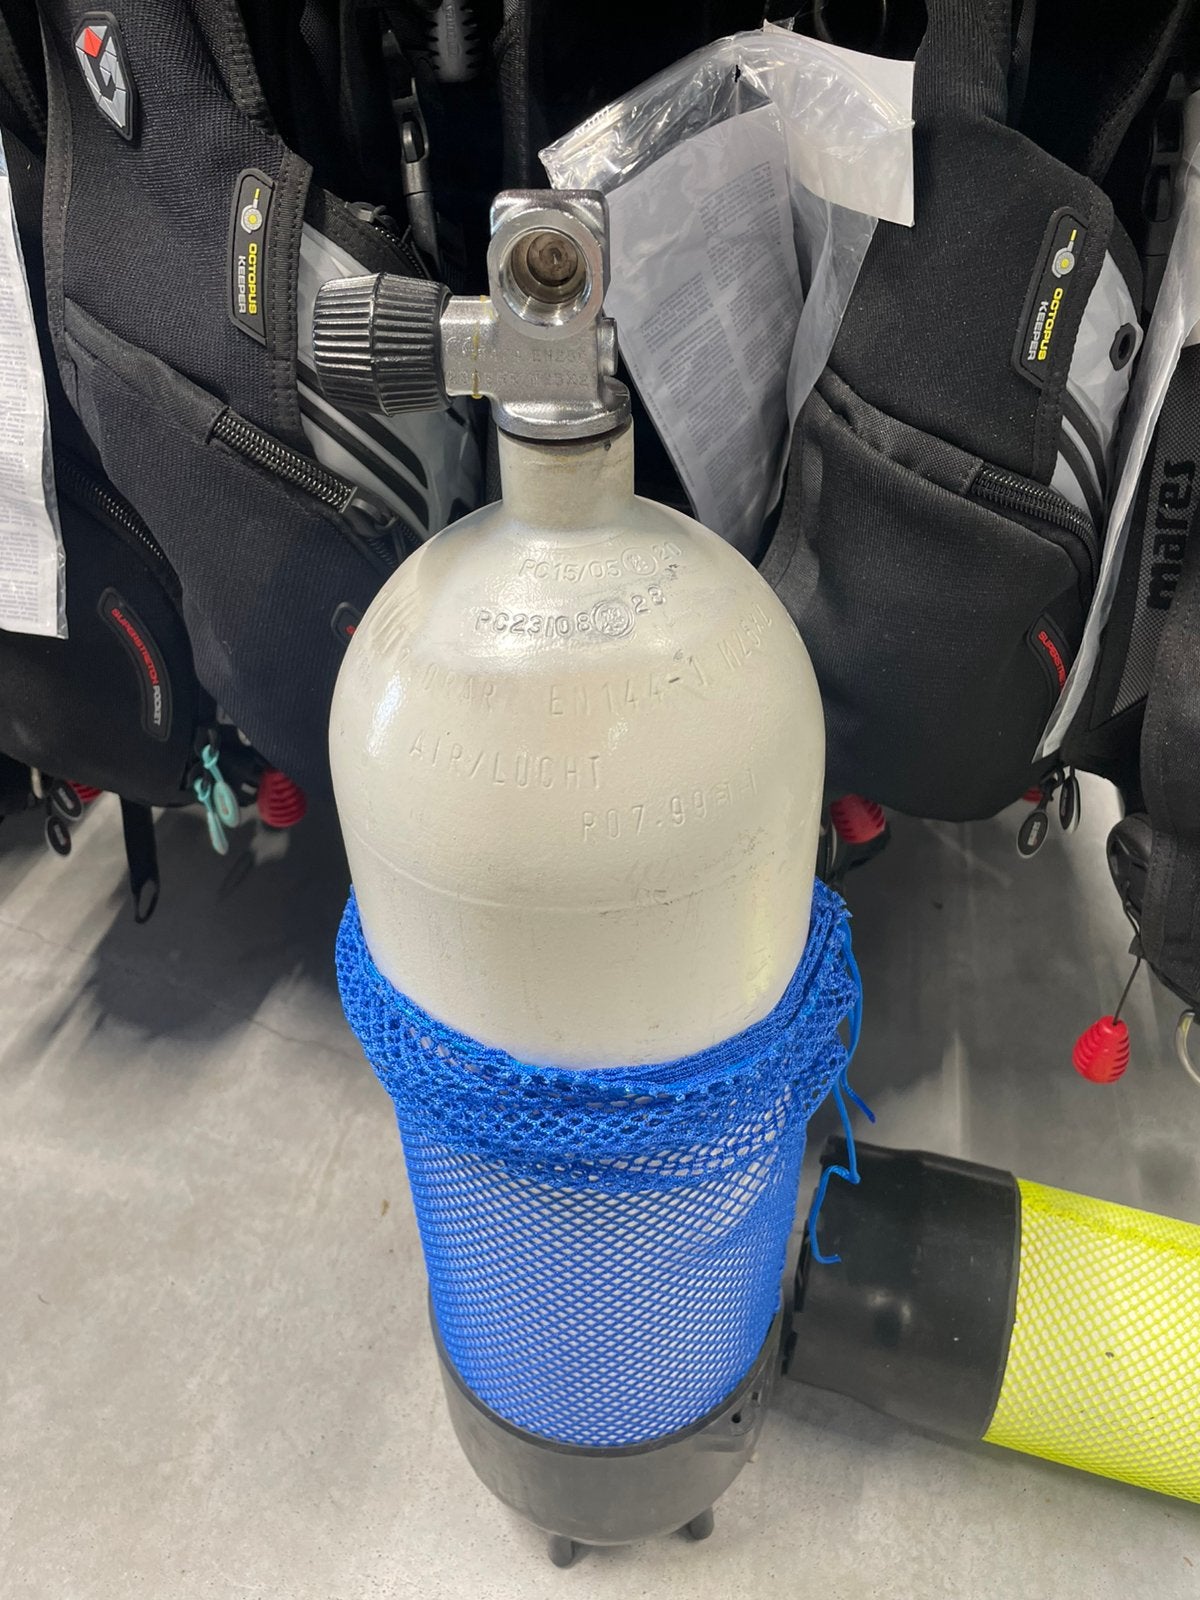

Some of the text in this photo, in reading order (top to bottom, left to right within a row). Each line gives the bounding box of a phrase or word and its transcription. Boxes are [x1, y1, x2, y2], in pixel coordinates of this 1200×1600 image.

[238, 255, 247, 313] KEEPER
[248, 243, 258, 314] OCTOPUS
[1027, 301, 1049, 361] KEEPER
[1037, 288, 1064, 361] OCTOPUS
[153, 685, 161, 726] POCKET
